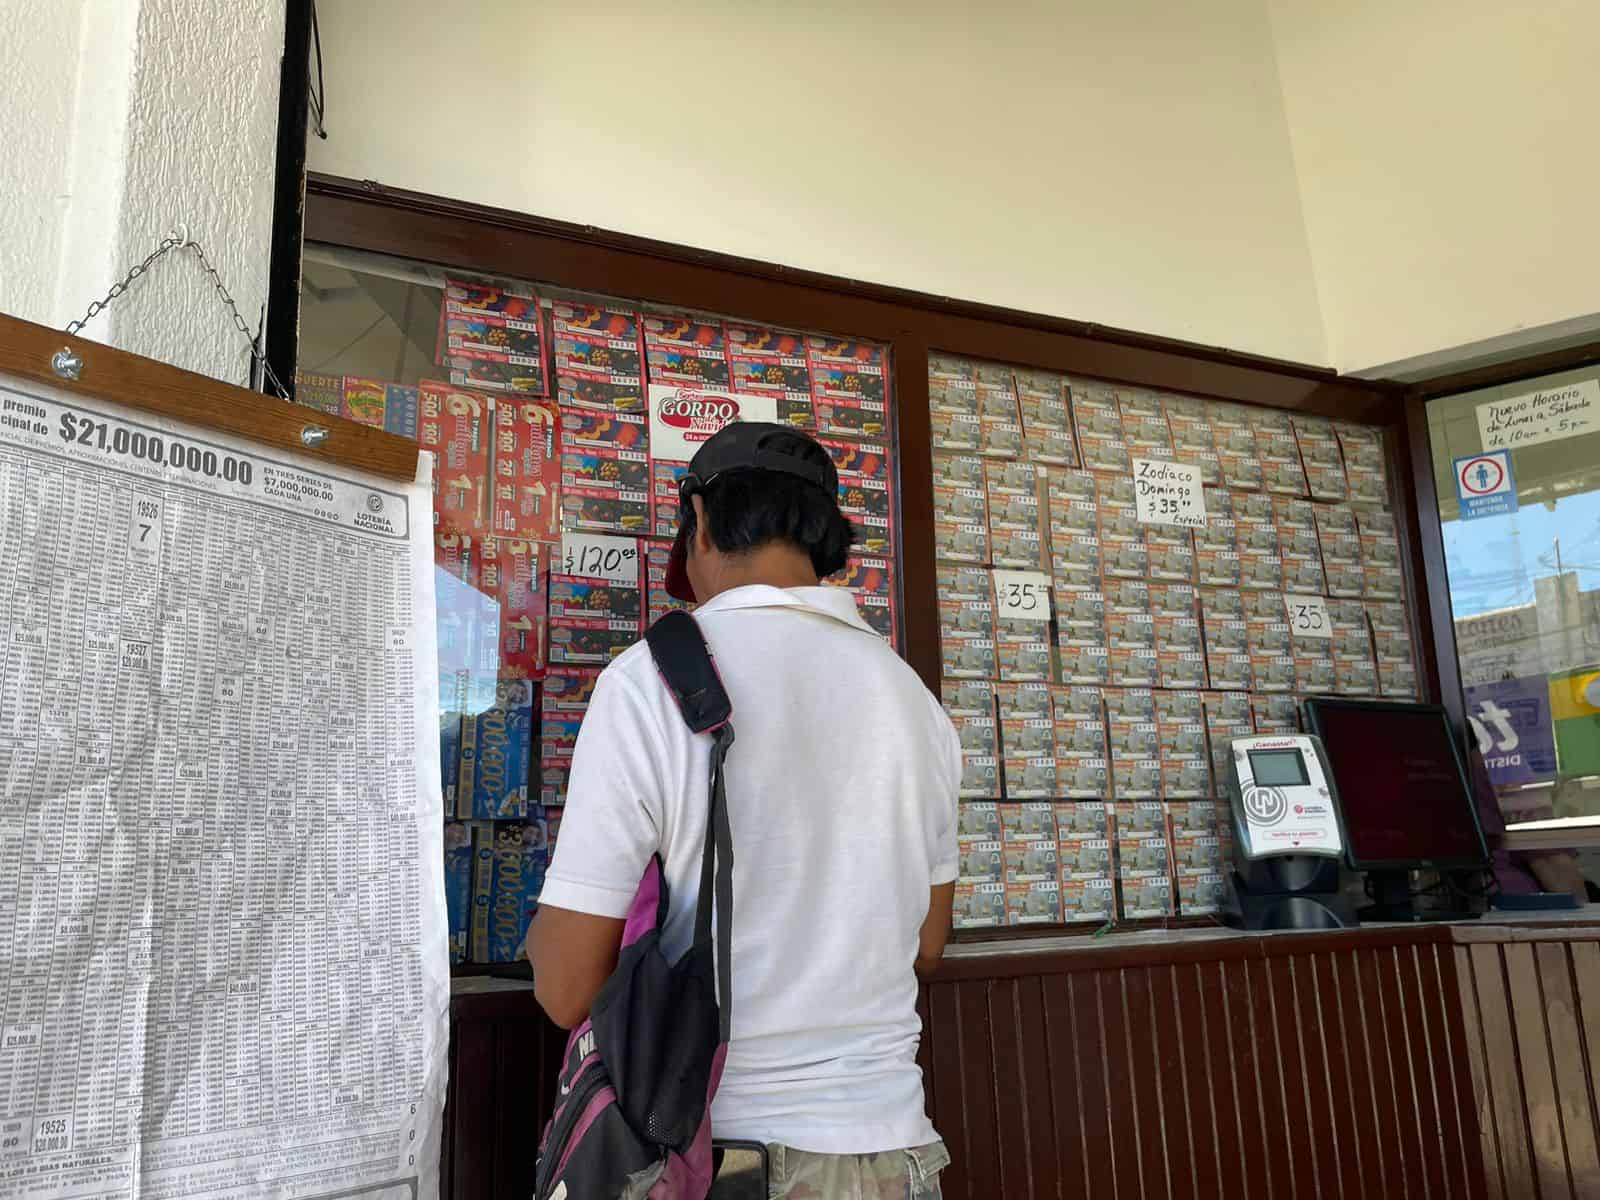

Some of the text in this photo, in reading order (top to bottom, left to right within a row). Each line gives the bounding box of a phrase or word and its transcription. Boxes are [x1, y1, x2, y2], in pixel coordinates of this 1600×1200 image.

[3, 399, 46, 418] premio
[425, 393, 438, 418] 500
[662, 399, 733, 419] GORDO
[1533, 391, 1579, 408] Horario
[501, 403, 513, 426] 500
[33, 421, 49, 435] de
[425, 422, 438, 445] 100
[60, 411, 252, 485] $21,000,000.00
[502, 430, 513, 453] 100
[502, 460, 513, 476] 20
[1139, 462, 1192, 482] Zodiaco
[264, 477, 333, 501] $7,000,000.00
[502, 484, 513, 499] 10
[1136, 479, 1190, 500] Domingo
[139, 523, 152, 542] 7
[354, 519, 395, 533] NACIONAL
[41, 1119, 67, 1136] 19525
